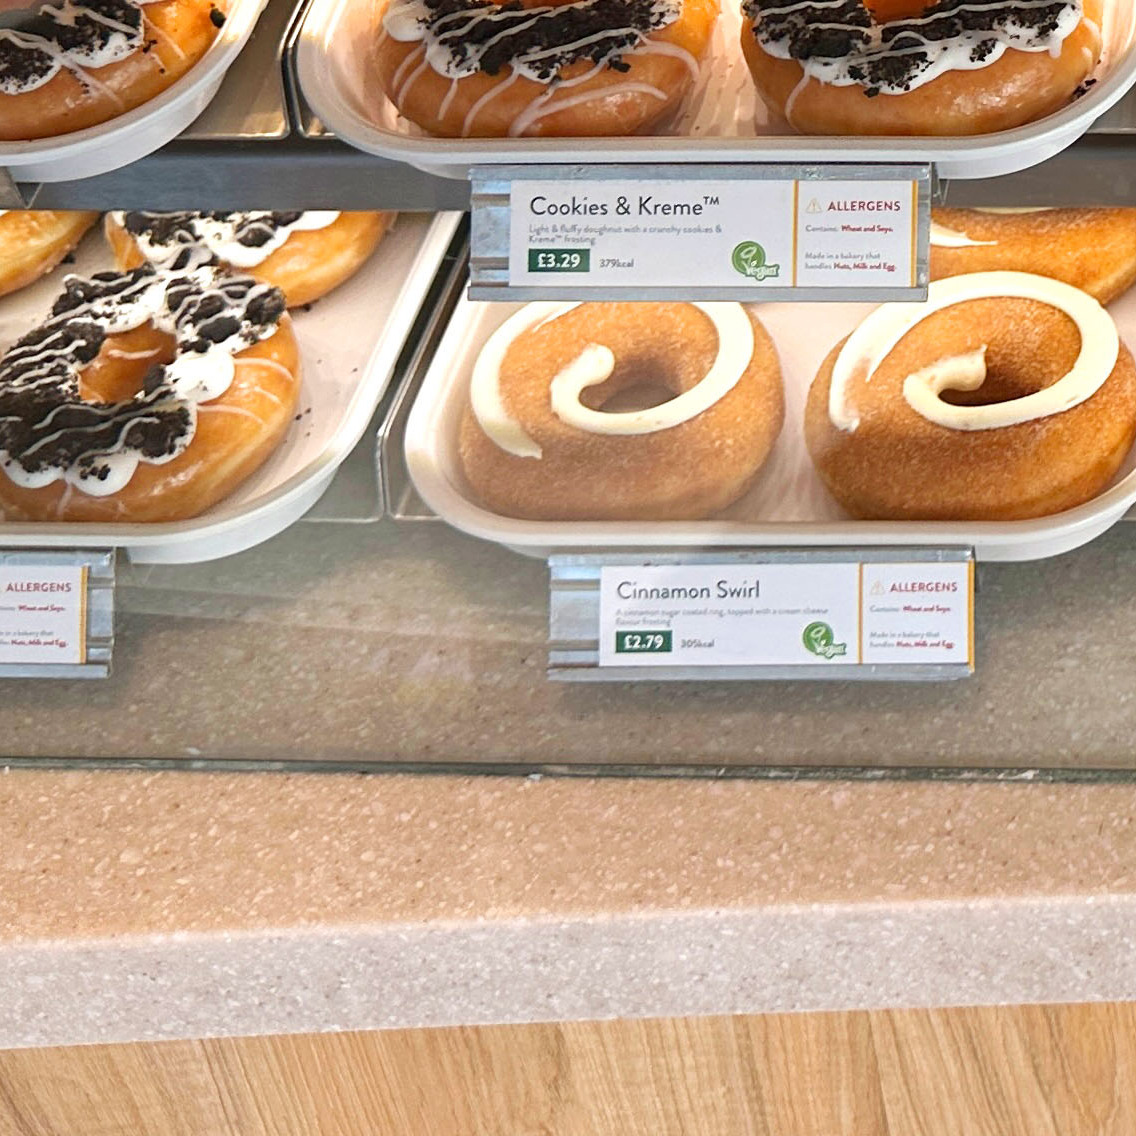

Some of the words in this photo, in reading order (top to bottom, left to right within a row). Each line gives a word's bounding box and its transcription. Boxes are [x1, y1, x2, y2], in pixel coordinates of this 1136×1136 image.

[530, 196, 608, 215] Cookies
[616, 196, 631, 215] &
[827, 201, 901, 212] ALLERGENS
[537, 253, 581, 268] £3.29
[599, 258, 634, 268] 379kcal
[6, 583, 72, 593] ALLERGENS
[617, 581, 711, 600] Cinnamon
[717, 579, 760, 599] Swirl
[890, 582, 958, 593] ALLERGENS
[624, 634, 664, 649] £2.79
[681, 639, 715, 649] 305kcal
